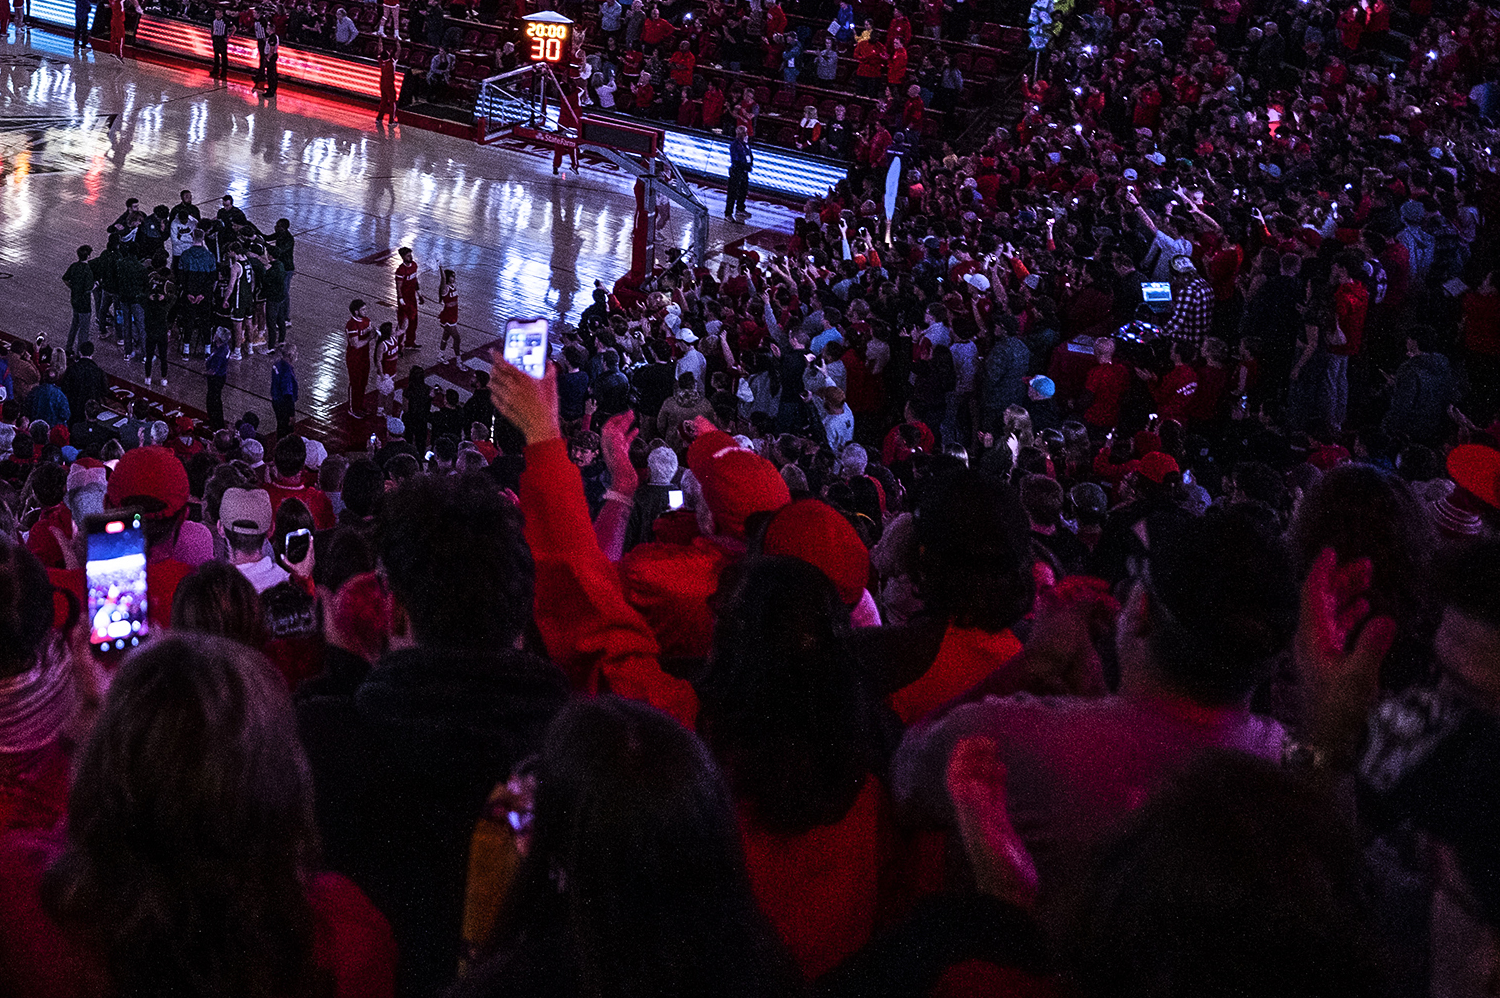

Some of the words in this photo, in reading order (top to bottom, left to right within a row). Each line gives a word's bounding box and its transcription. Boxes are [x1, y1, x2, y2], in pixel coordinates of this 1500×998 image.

[526, 22, 567, 39] 20:00
[530, 37, 562, 61] 30
[246, 269, 252, 283] 5
